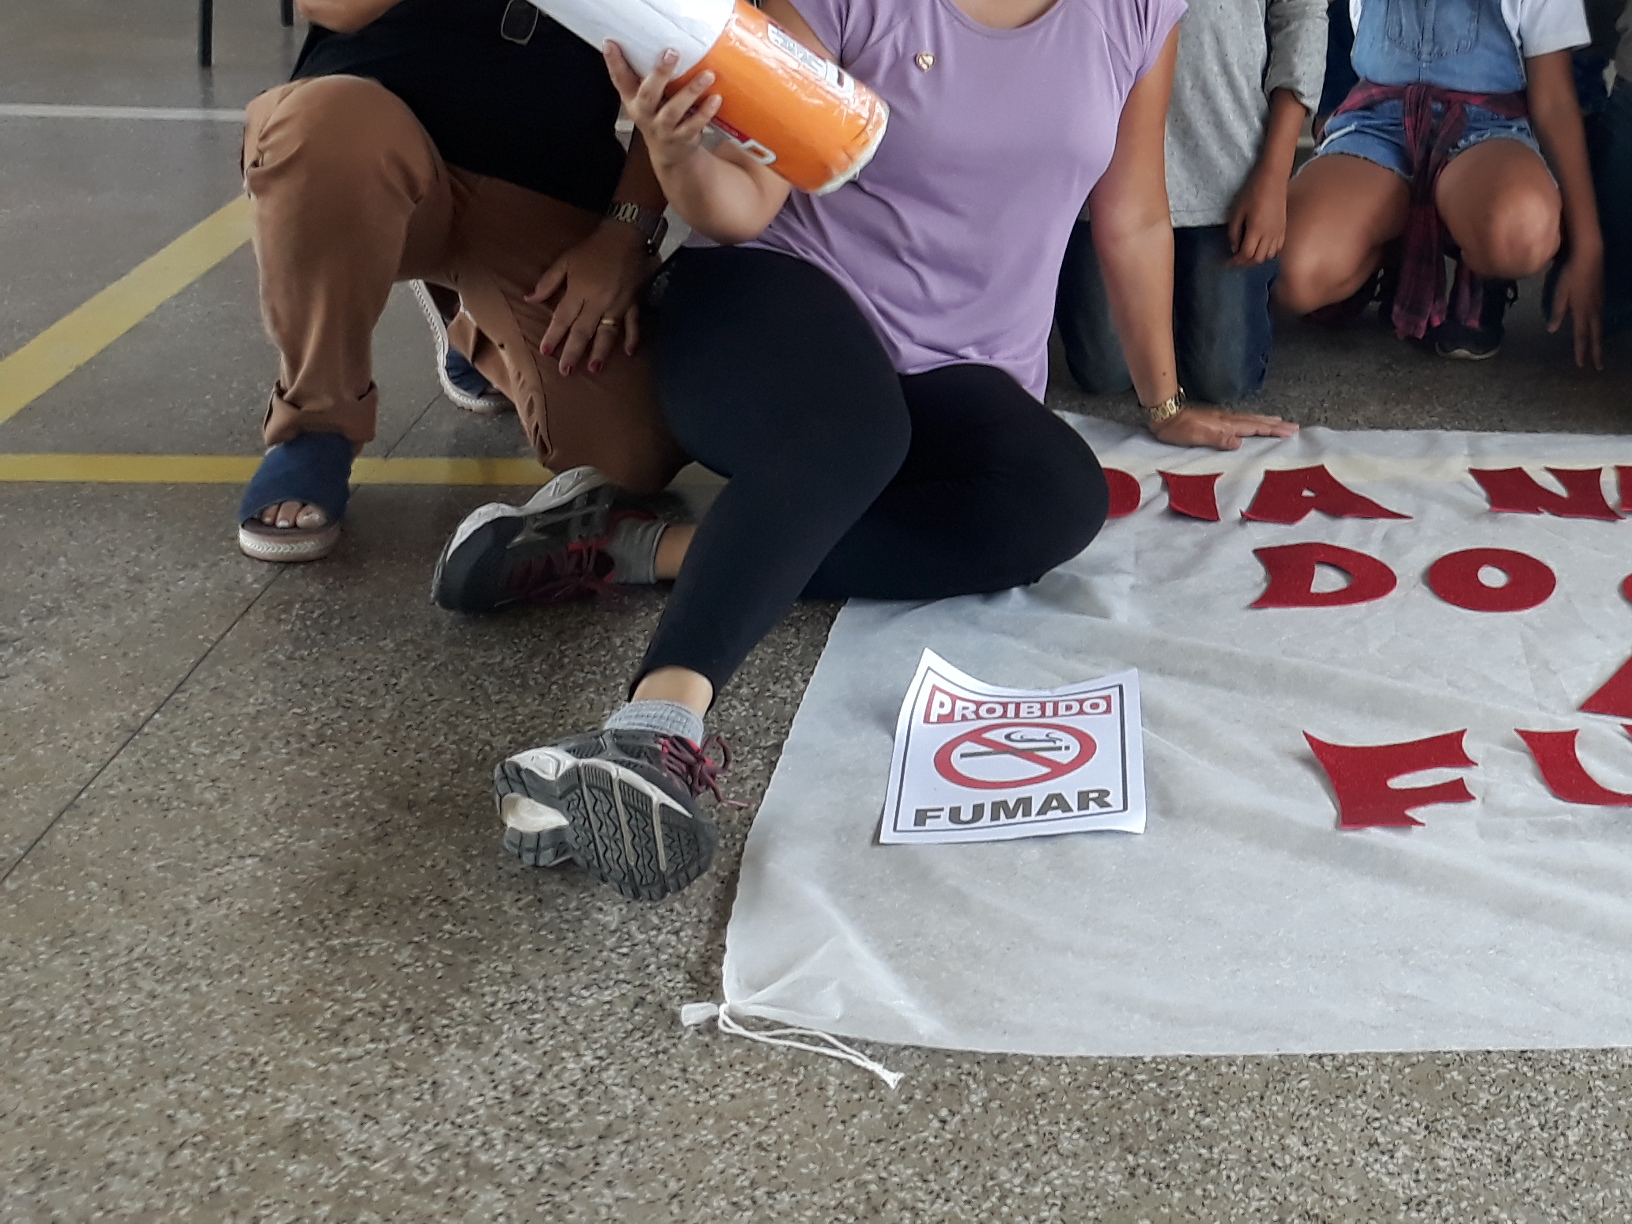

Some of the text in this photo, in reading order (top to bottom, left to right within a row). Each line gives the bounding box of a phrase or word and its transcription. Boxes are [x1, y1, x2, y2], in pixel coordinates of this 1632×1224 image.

[1249, 542, 1557, 613] DO
[928, 688, 1109, 724] PROIBIDO
[913, 788, 1114, 828] FUMAR
